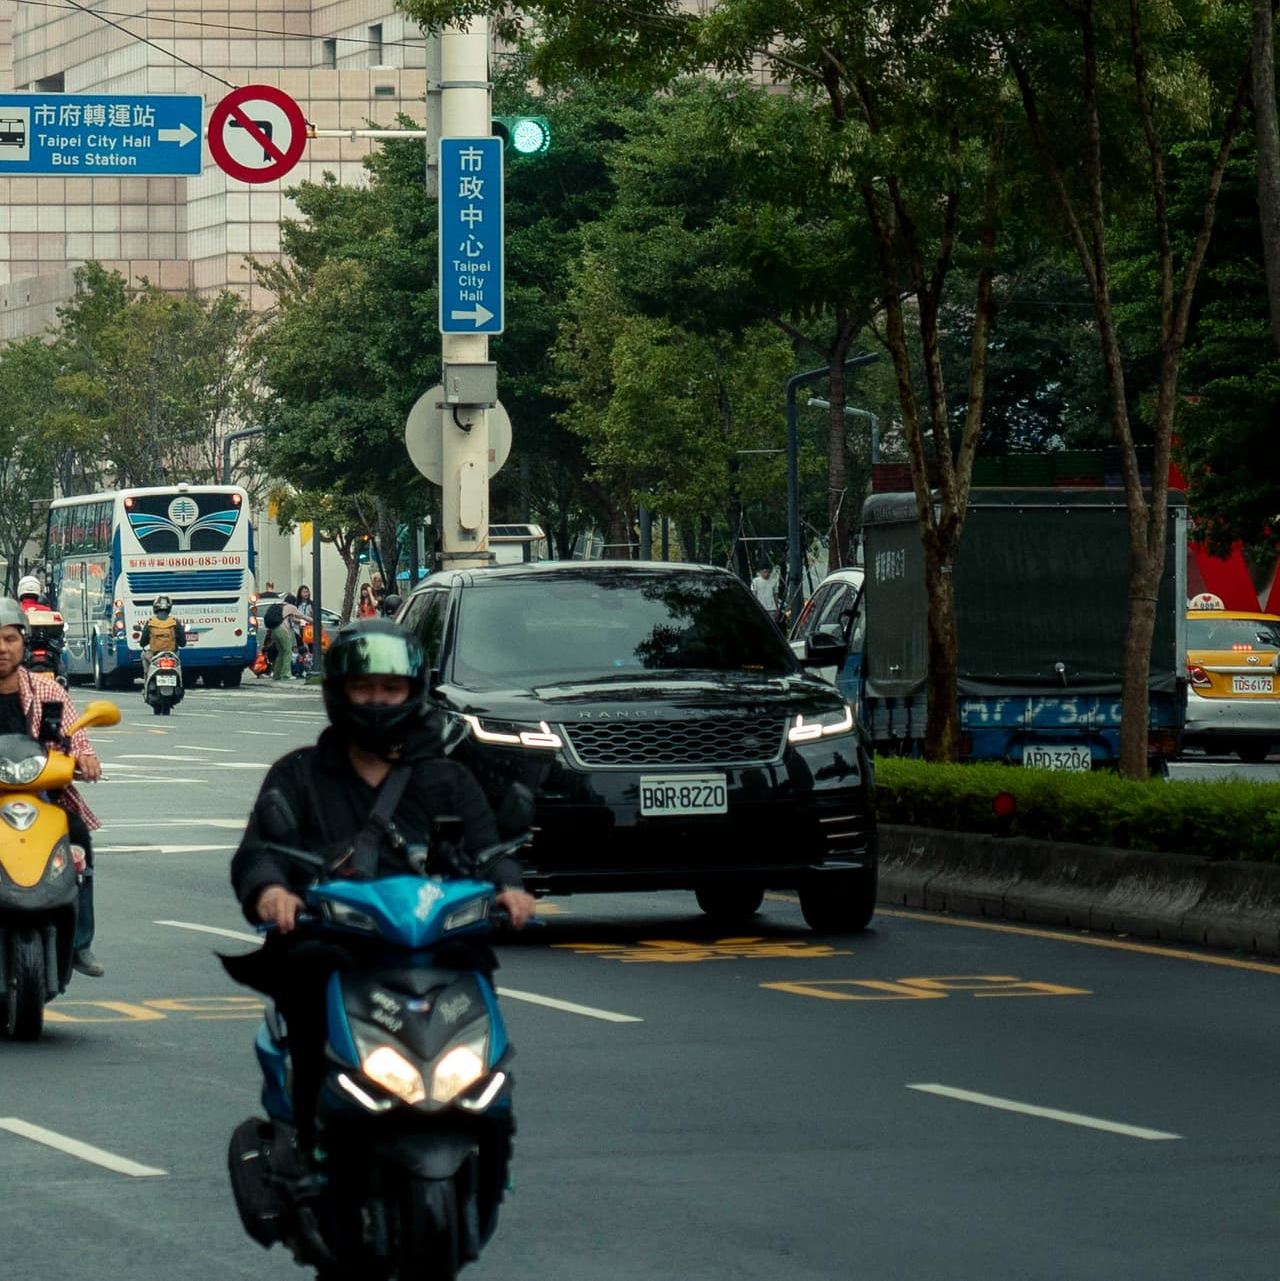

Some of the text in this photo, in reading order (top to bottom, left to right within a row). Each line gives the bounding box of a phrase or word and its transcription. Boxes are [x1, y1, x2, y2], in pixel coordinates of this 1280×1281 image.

[33, 103, 156, 128] 市府轉運站
[37, 134, 151, 150] Taipei City Hall
[52, 152, 137, 166] Bus Station
[458, 145, 484, 258] 市政中心
[452, 260, 491, 274] Taipei
[458, 275, 484, 289] City
[459, 290, 484, 302] Hall
[642, 785, 725, 810] BQR-8220
